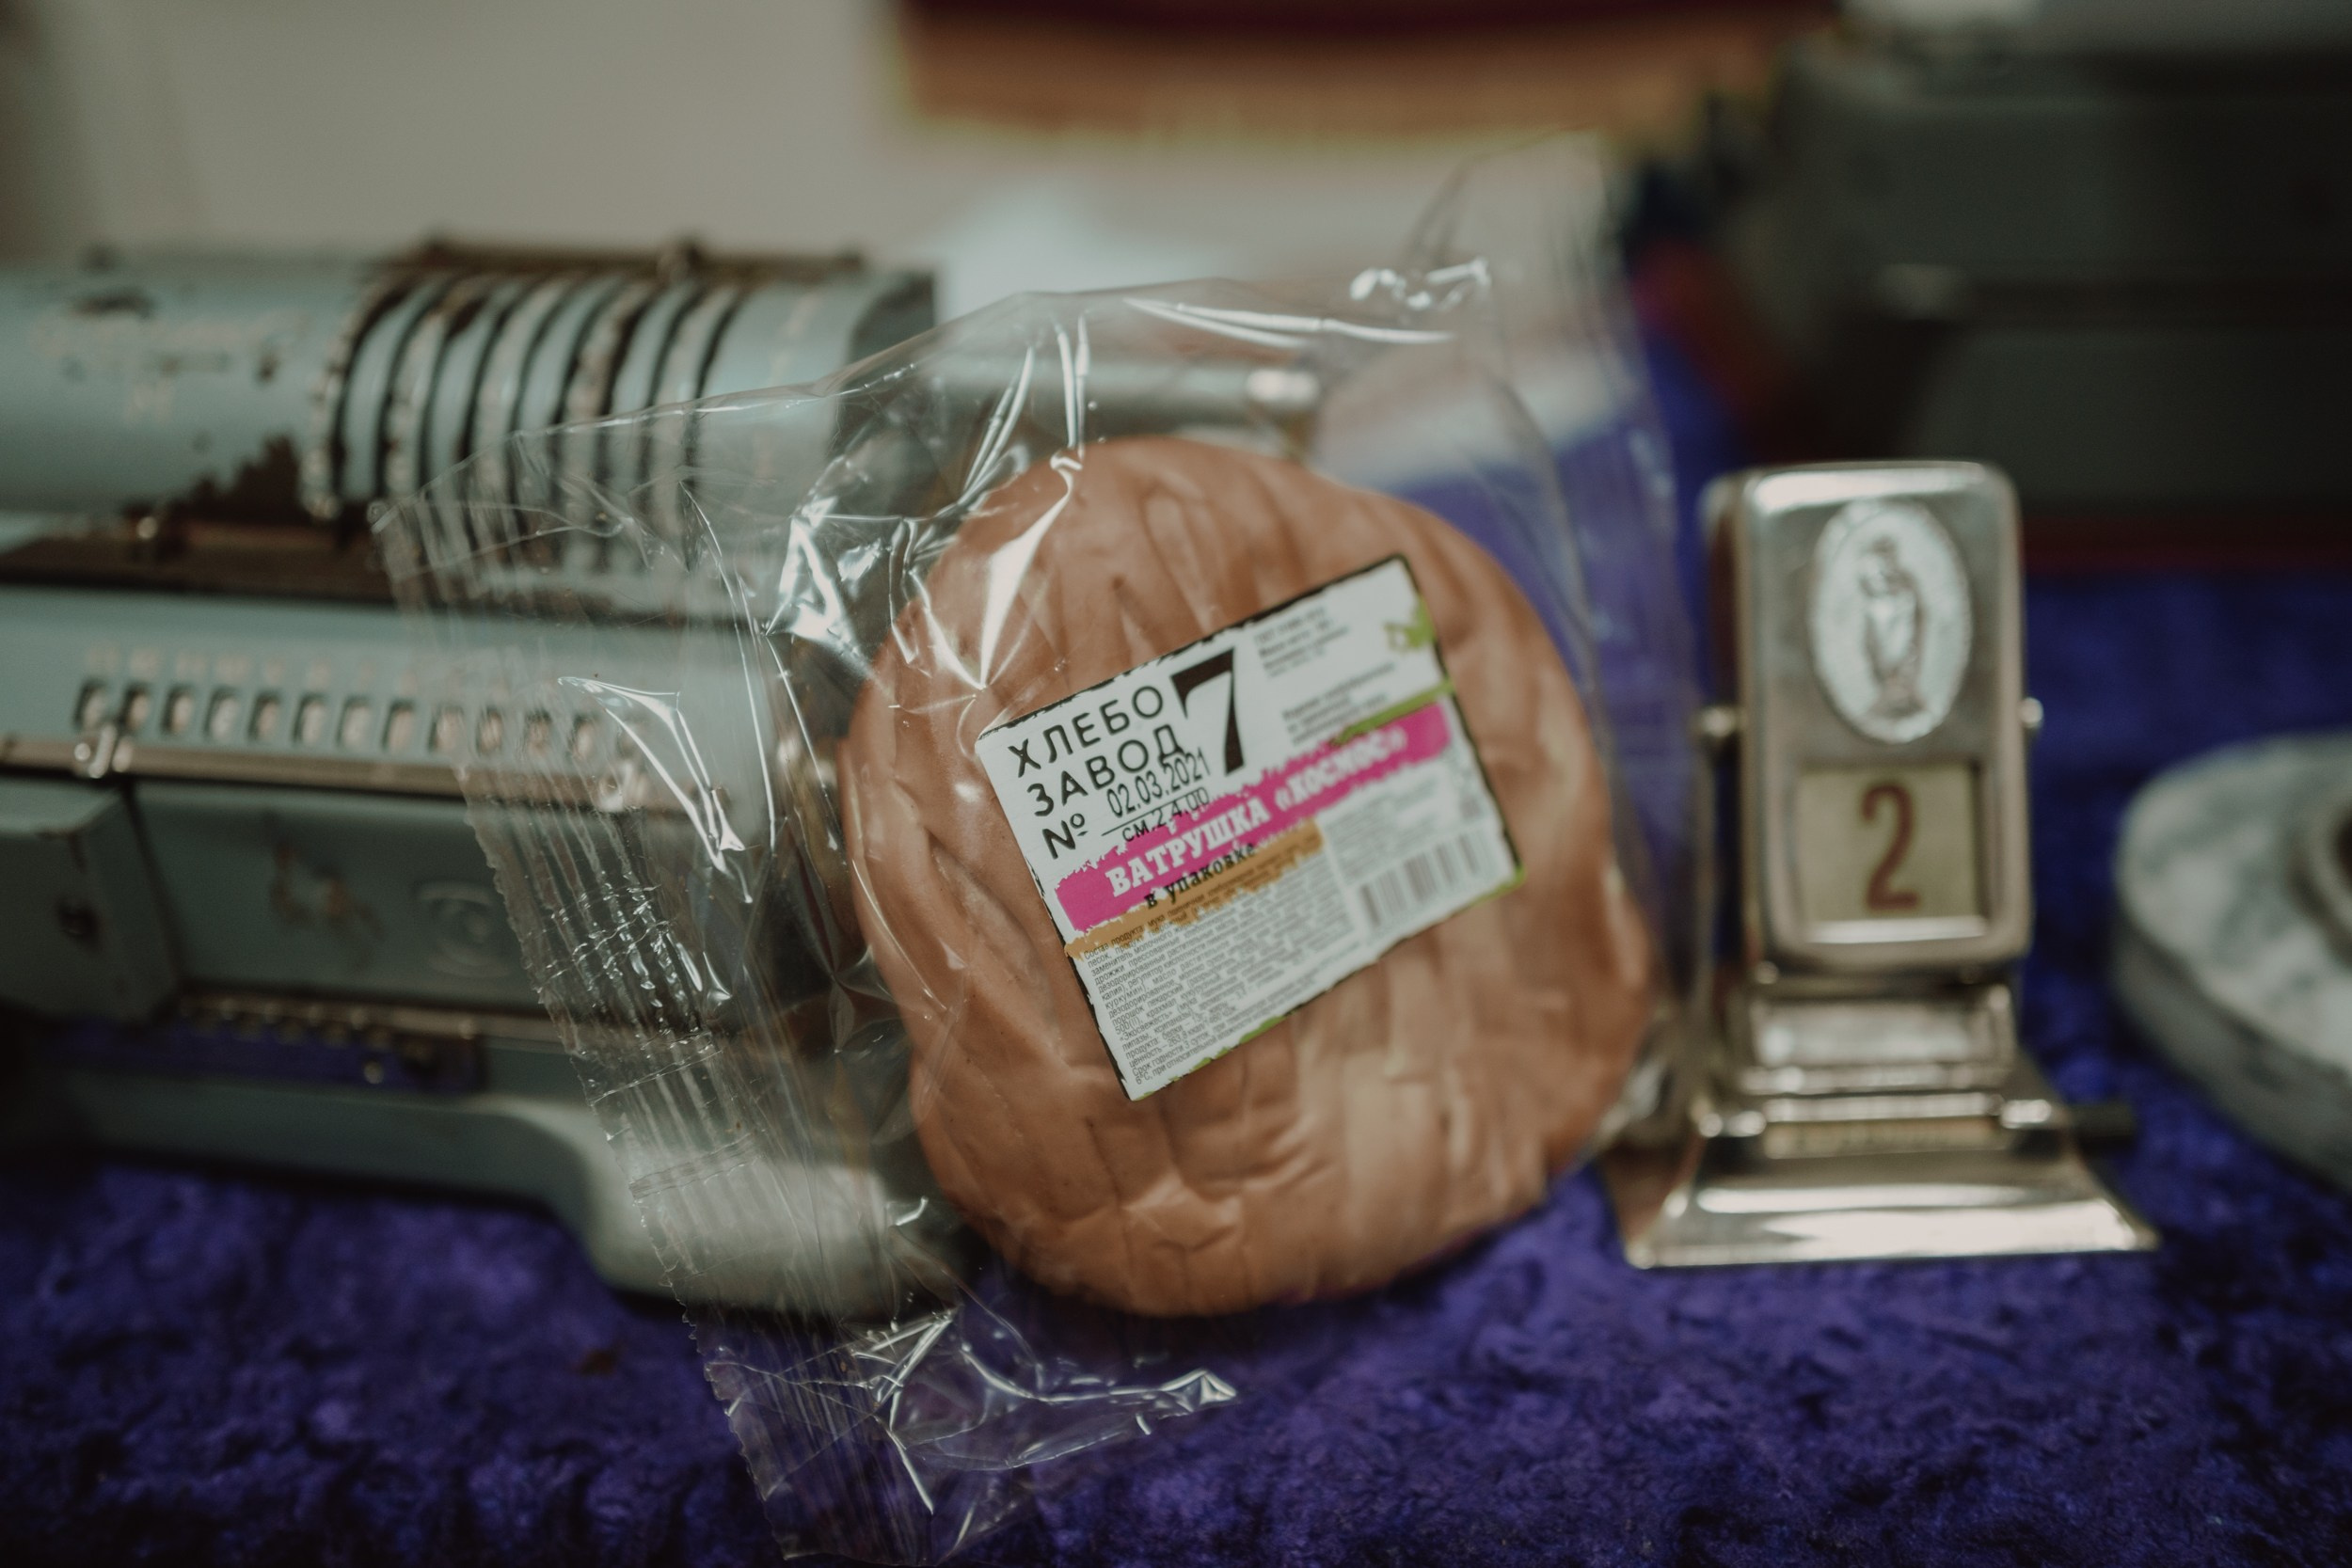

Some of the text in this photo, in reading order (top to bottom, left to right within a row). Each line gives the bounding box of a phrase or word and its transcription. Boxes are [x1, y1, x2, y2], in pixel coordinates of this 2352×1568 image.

[1008, 685, 1164, 778] ХЛЕБО
[1169, 649, 1246, 774] 7
[1025, 722, 1184, 817] ЗАВОД
[1106, 746, 1211, 818] 02.03.2021
[1040, 810, 1094, 860] №
[1104, 794, 1271, 898] ВАТРУШКА
[1860, 782, 1920, 912] 2
[1142, 891, 1159, 910] в
[1162, 840, 1259, 905] упаковке
[1089, 949, 1134, 977] заменитель
[1093, 963, 1125, 987] дрожжи
[1151, 966, 1178, 986] масло
[1110, 1003, 1145, 1028] порошок
[1131, 1059, 1152, 1079] Срок
[1150, 1042, 1184, 1068] годности
